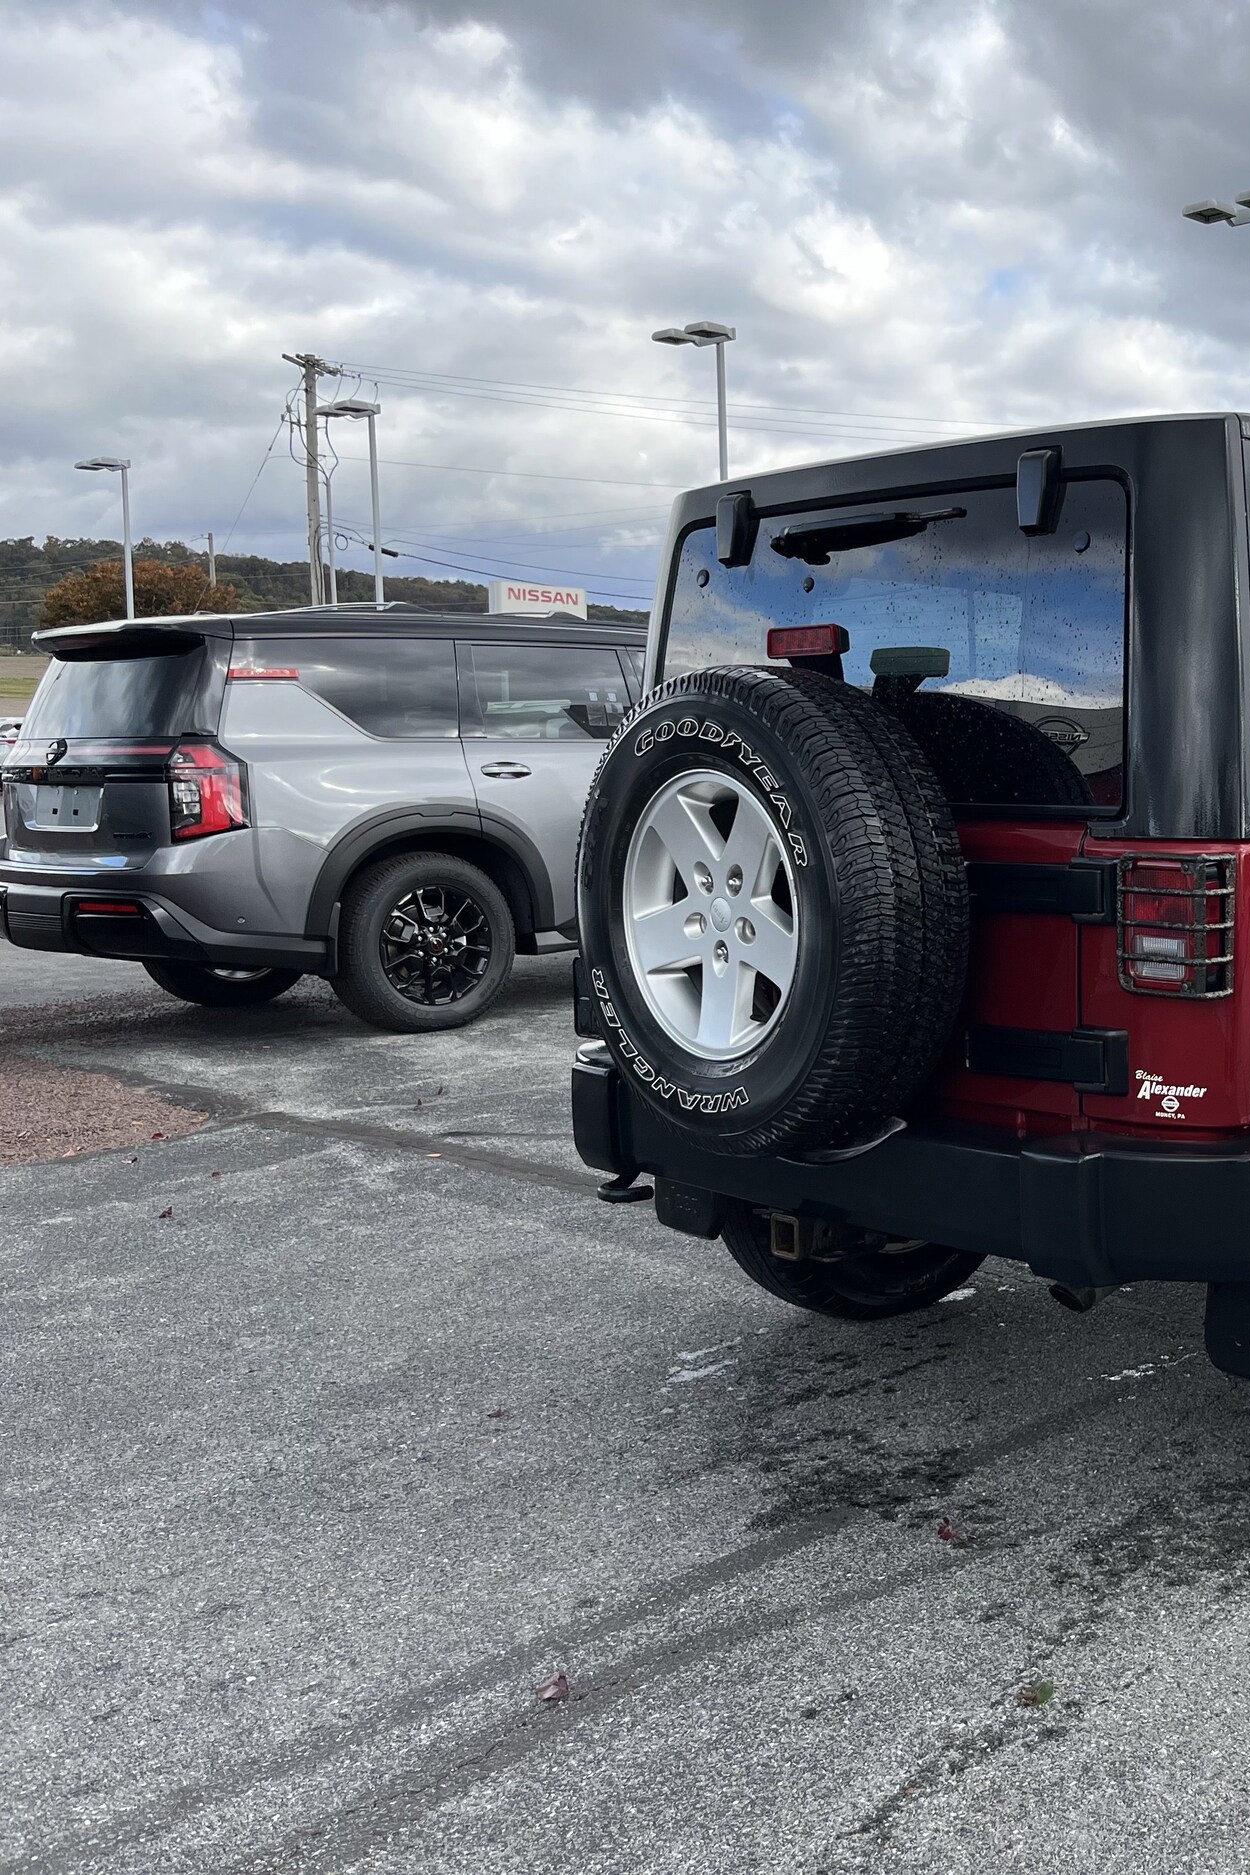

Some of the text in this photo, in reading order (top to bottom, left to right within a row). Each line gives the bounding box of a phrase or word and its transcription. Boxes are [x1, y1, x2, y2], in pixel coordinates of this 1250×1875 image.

[507, 587, 579, 605] NISSAN
[633, 716, 808, 868] GOODYEAR
[591, 967, 751, 1114] WRANGLER
[1135, 1069, 1164, 1082] Blaise
[1136, 1080, 1208, 1100] Alexander
[1177, 1112, 1186, 1120] PA
